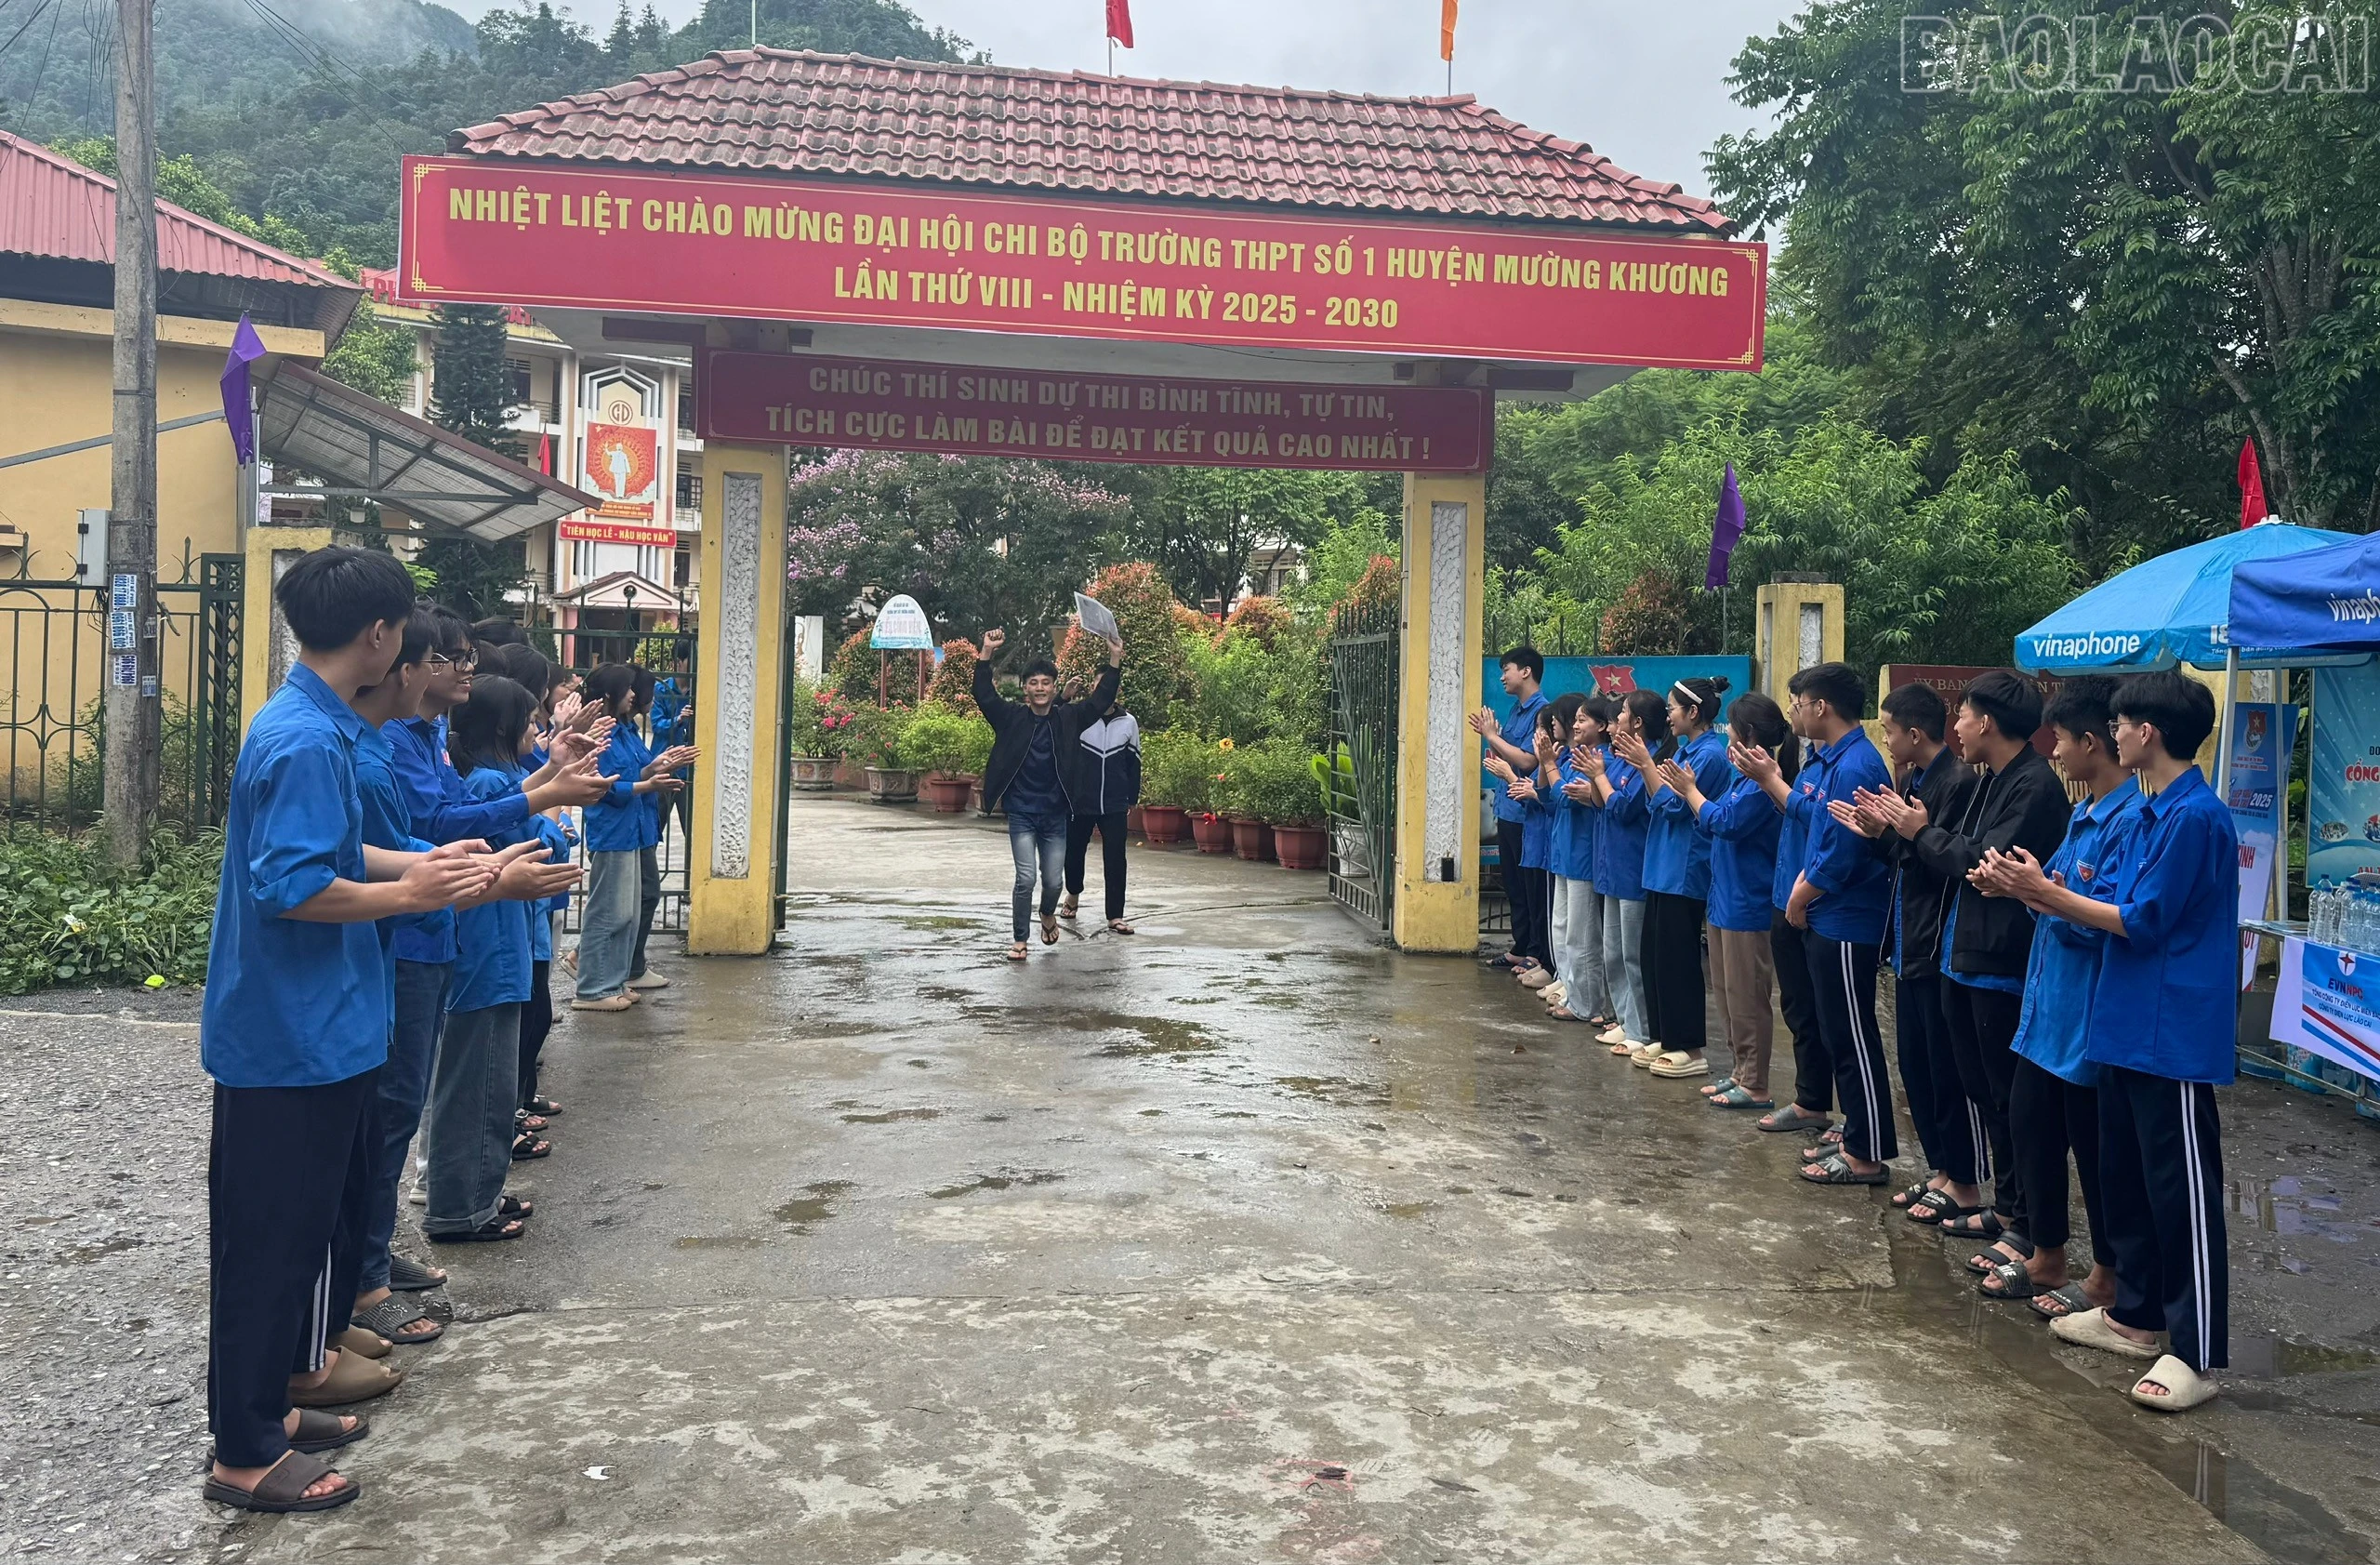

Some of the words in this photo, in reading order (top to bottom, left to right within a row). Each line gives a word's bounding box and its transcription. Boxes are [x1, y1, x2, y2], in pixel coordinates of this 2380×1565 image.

[449, 185, 551, 231] NHIỆT
[562, 190, 632, 235] LIỆT
[642, 195, 734, 236] CHÀO
[744, 201, 844, 244] MỪNG
[853, 214, 909, 253] ĐẠI
[919, 213, 973, 258] HỘI
[984, 221, 1037, 256] CHI
[1047, 222, 1088, 266] BỘ
[1098, 228, 1222, 268] TRƯỜNG
[1231, 239, 1305, 272] THPT
[1314, 234, 1354, 275] SỐ
[1363, 246, 1375, 276] 1
[1387, 245, 1485, 287] HUYỆN
[1494, 250, 1601, 290] MƯỜNG
[1609, 261, 1729, 297] KHƯƠNG
[835, 258, 898, 301] LẦN
[907, 267, 973, 305] THỨ
[979, 275, 1032, 309] VIII
[1063, 279, 1167, 322] NHIỆM
[1175, 285, 1214, 320] KỲ
[1223, 292, 1297, 325] 2025
[1325, 297, 1398, 328] 2030
[809, 365, 892, 396] CHÚC
[900, 371, 948, 400] THÍ
[958, 376, 1029, 404] SINH
[1038, 380, 1080, 411] DỰ
[1085, 384, 1130, 409] THI
[1139, 383, 1208, 413] BÌNH
[1216, 386, 1290, 418] TĨNH,
[1300, 392, 1337, 421] TỰ
[1341, 395, 1394, 421] TIN,
[765, 403, 835, 431] TÍCH
[845, 411, 906, 443] CỰC
[915, 411, 977, 442] LÀM
[988, 417, 1037, 445] BÀI
[1045, 415, 1085, 448] ĐỂ
[1091, 426, 1145, 456] ĐẠT
[1154, 422, 1206, 454] KẾT
[1213, 424, 1270, 458] QUẢ
[1278, 432, 1332, 458] CAO
[1341, 428, 1413, 459] NHẤT
[2033, 631, 2140, 659] vinaphone
[2250, 792, 2273, 807] 2025
